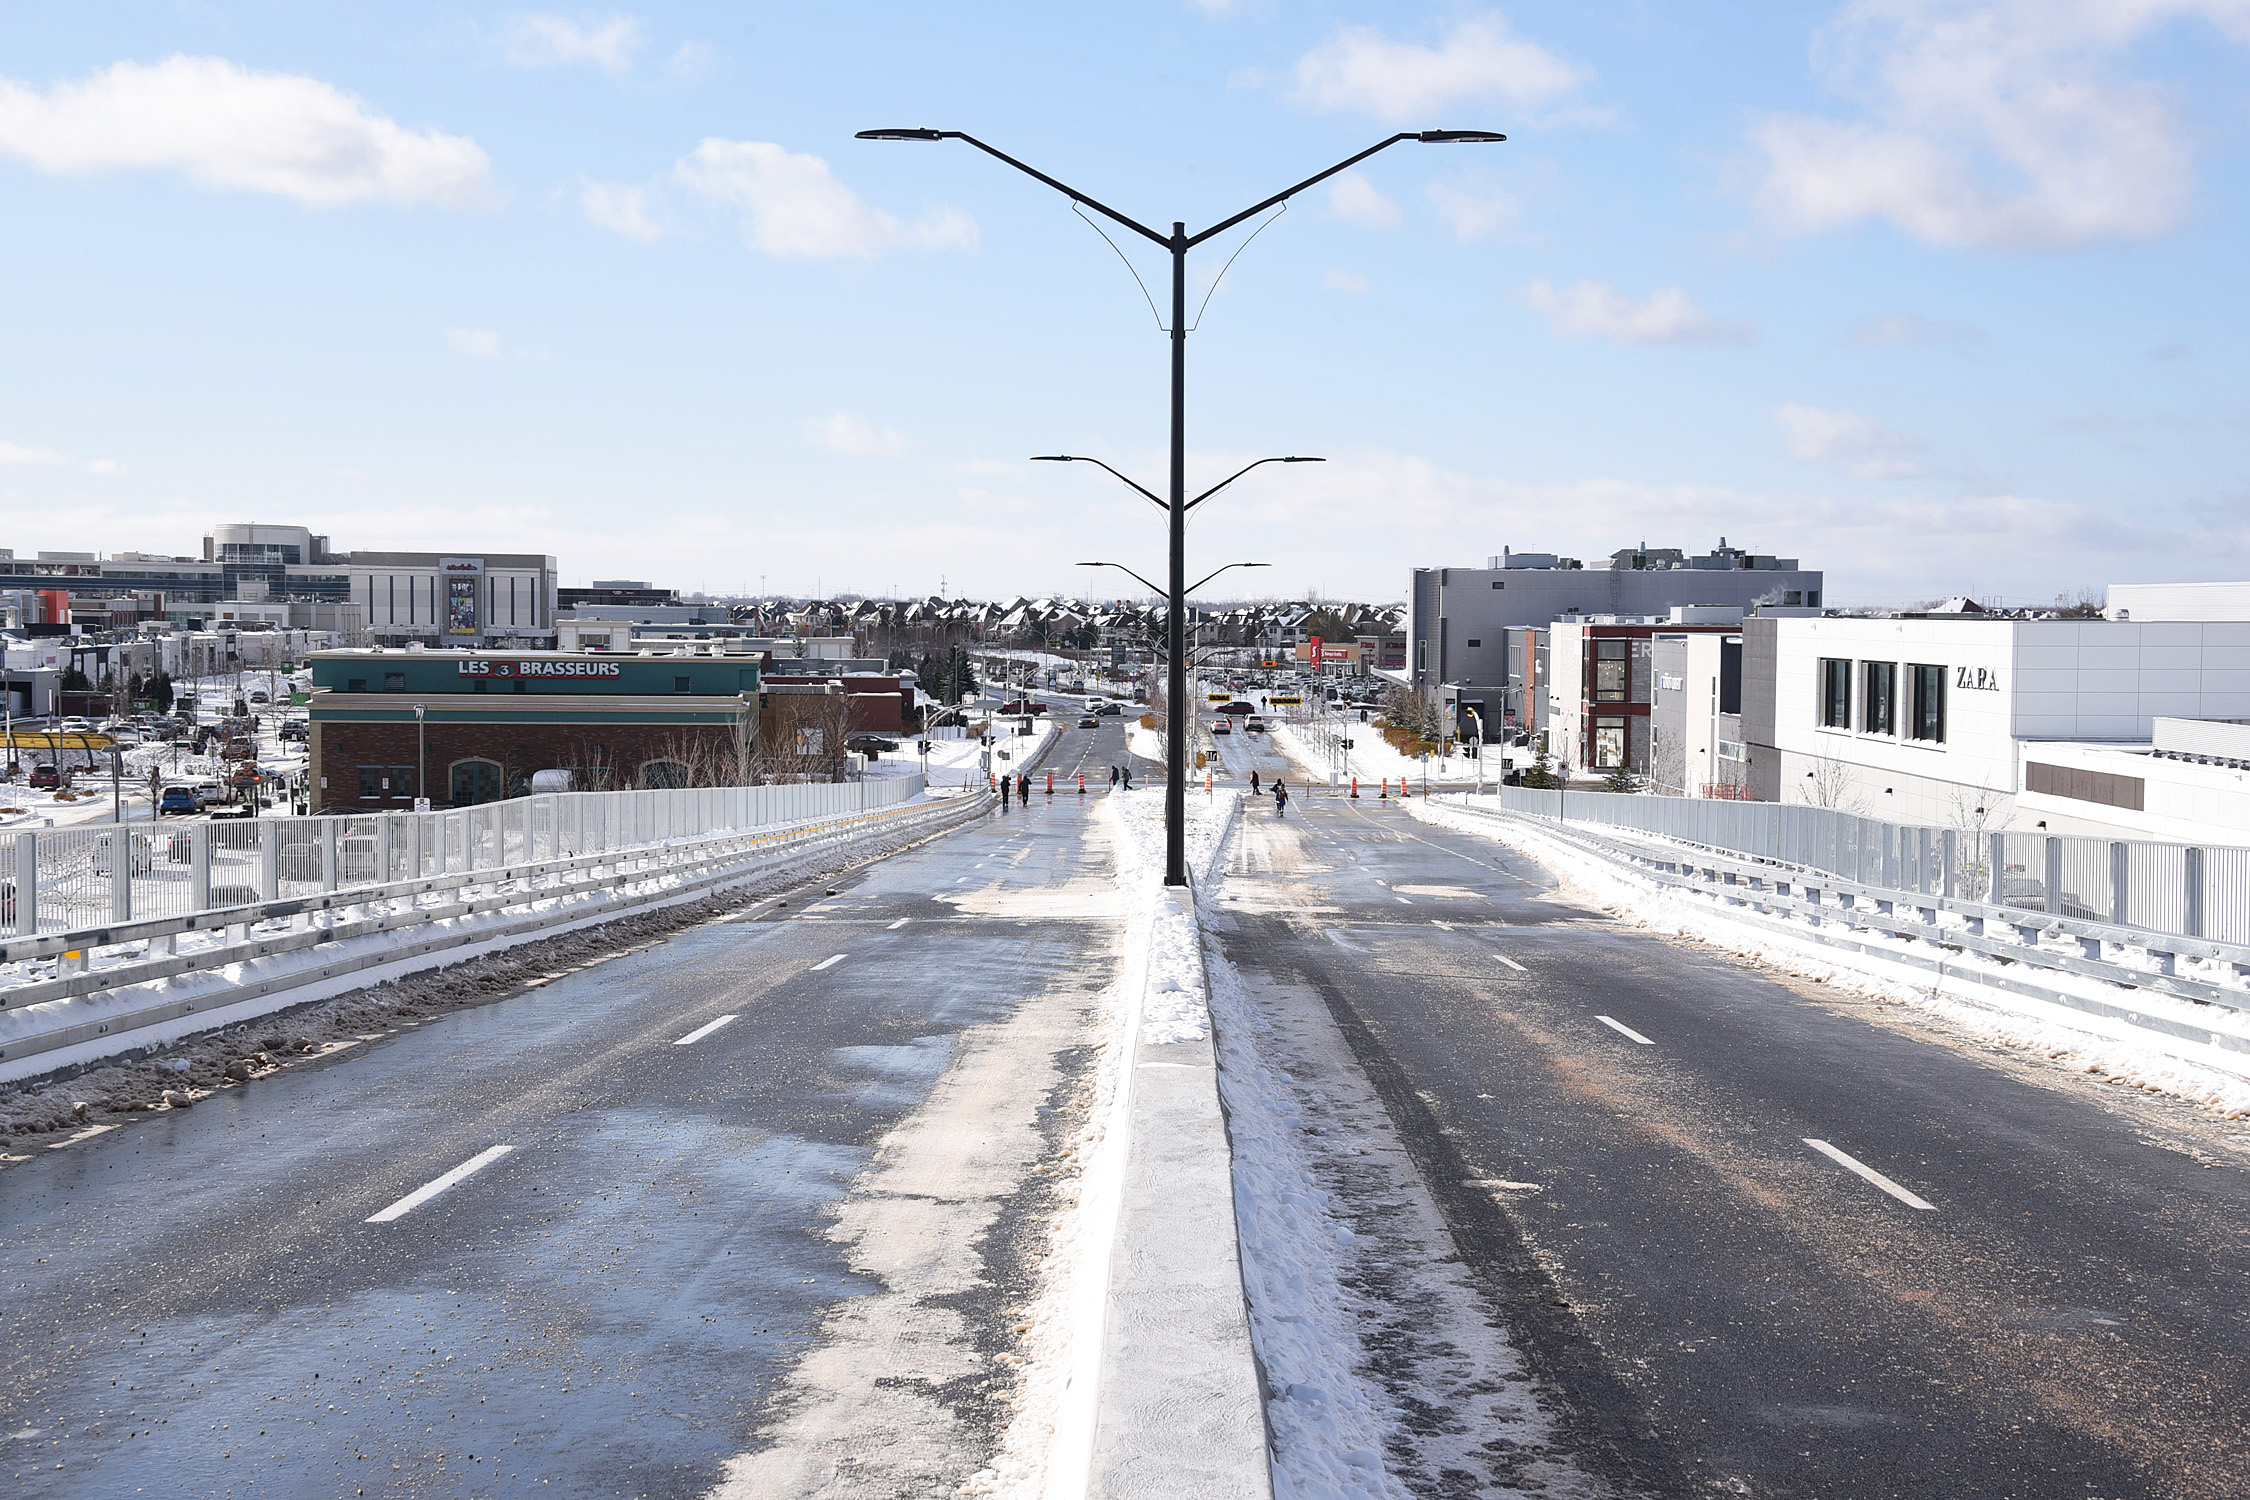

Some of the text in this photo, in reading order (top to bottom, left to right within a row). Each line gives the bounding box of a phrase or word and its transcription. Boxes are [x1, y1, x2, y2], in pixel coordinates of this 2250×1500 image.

[458, 661, 620, 676] LES 3 BRASSEURS
[1956, 665, 2000, 691] ZARA
